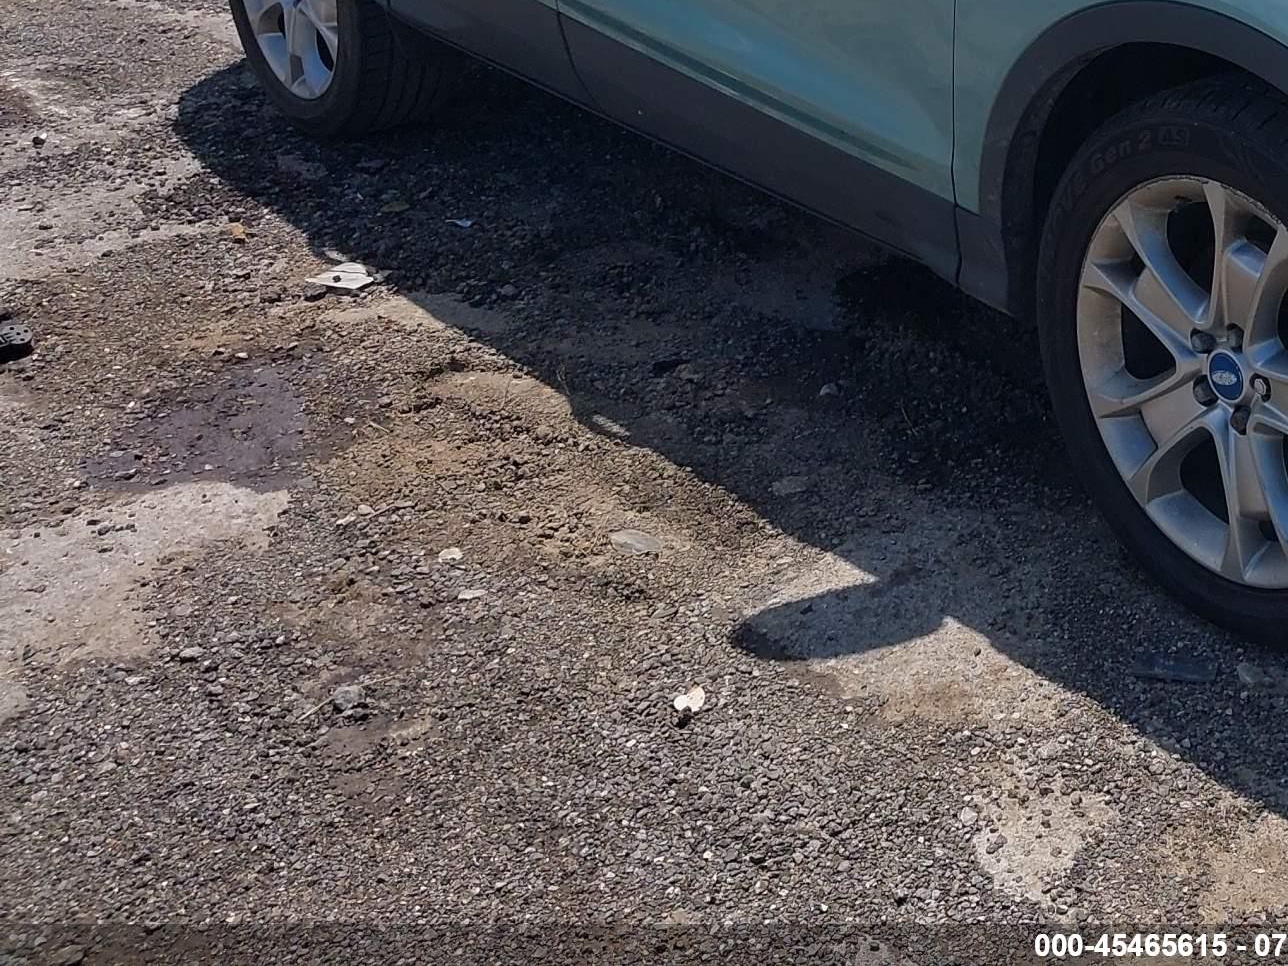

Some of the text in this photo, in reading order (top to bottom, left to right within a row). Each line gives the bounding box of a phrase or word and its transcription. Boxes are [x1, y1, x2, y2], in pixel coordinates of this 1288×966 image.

[1091, 140, 1132, 173] Gen
[1138, 130, 1153, 151] 2
[1160, 127, 1189, 146] AS
